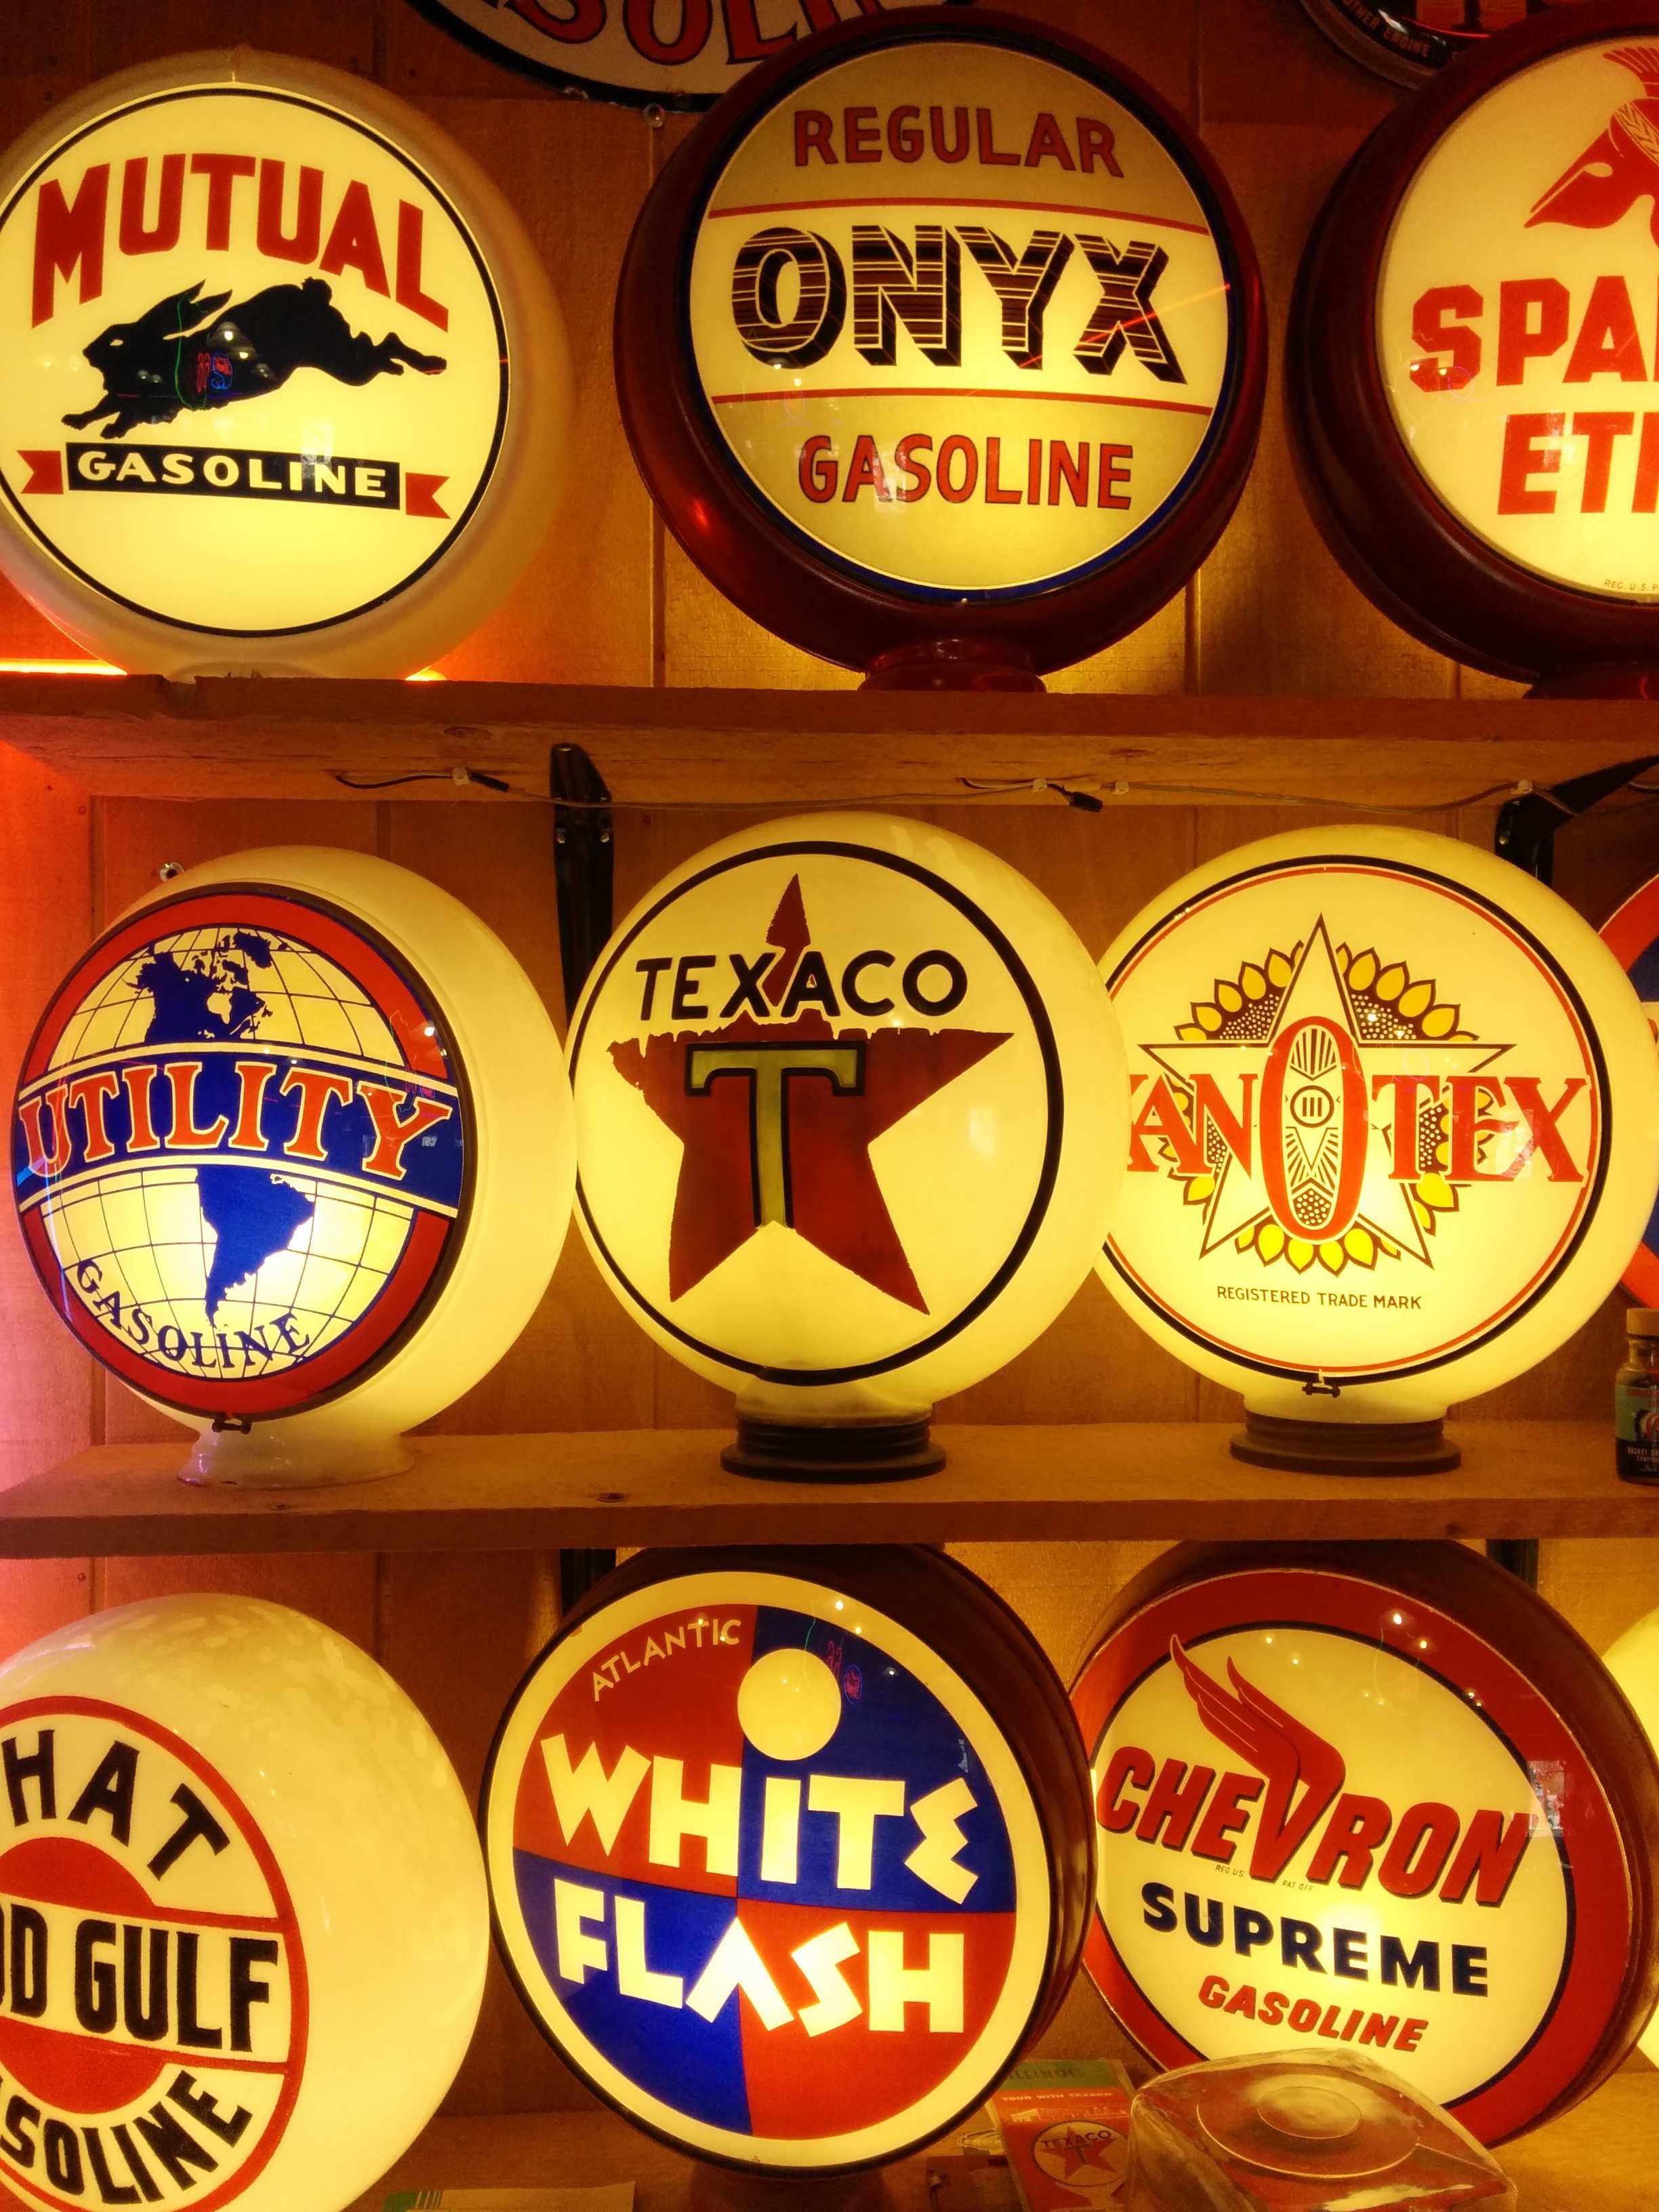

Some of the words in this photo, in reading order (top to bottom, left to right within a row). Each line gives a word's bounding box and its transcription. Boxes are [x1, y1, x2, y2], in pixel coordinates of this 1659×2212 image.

[794, 105, 1124, 178] REGULAR
[31, 152, 449, 333] MUTUAL
[732, 224, 1188, 385] ONYX
[1410, 274, 1659, 393] SPA
[77, 451, 386, 498] GASOLINE
[798, 432, 1134, 510] GASOLINE
[636, 949, 968, 1021] TEXACO
[19, 1060, 453, 1181] UTILITY
[684, 1041, 867, 1230] T
[76, 1258, 312, 1370] GASOLINE
[1217, 1286, 1311, 1305] REGISTERED
[1317, 1292, 1368, 1308] TRADE
[1373, 1294, 1422, 1311] MARK
[589, 1619, 742, 1702] ATLANTIC
[540, 1733, 979, 1905] WHITE
[1096, 1746, 1536, 1909] CHEVRON
[0, 1903, 48, 2019] D
[74, 1918, 279, 2053] GULF
[554, 1878, 965, 2038] FLASH
[1141, 1881, 1489, 1999] SUPREME
[1197, 1974, 1429, 2053] GASOLINE
[0, 2070, 253, 2206] SOLINE
[1040, 2129, 1112, 2148] TEXACO
